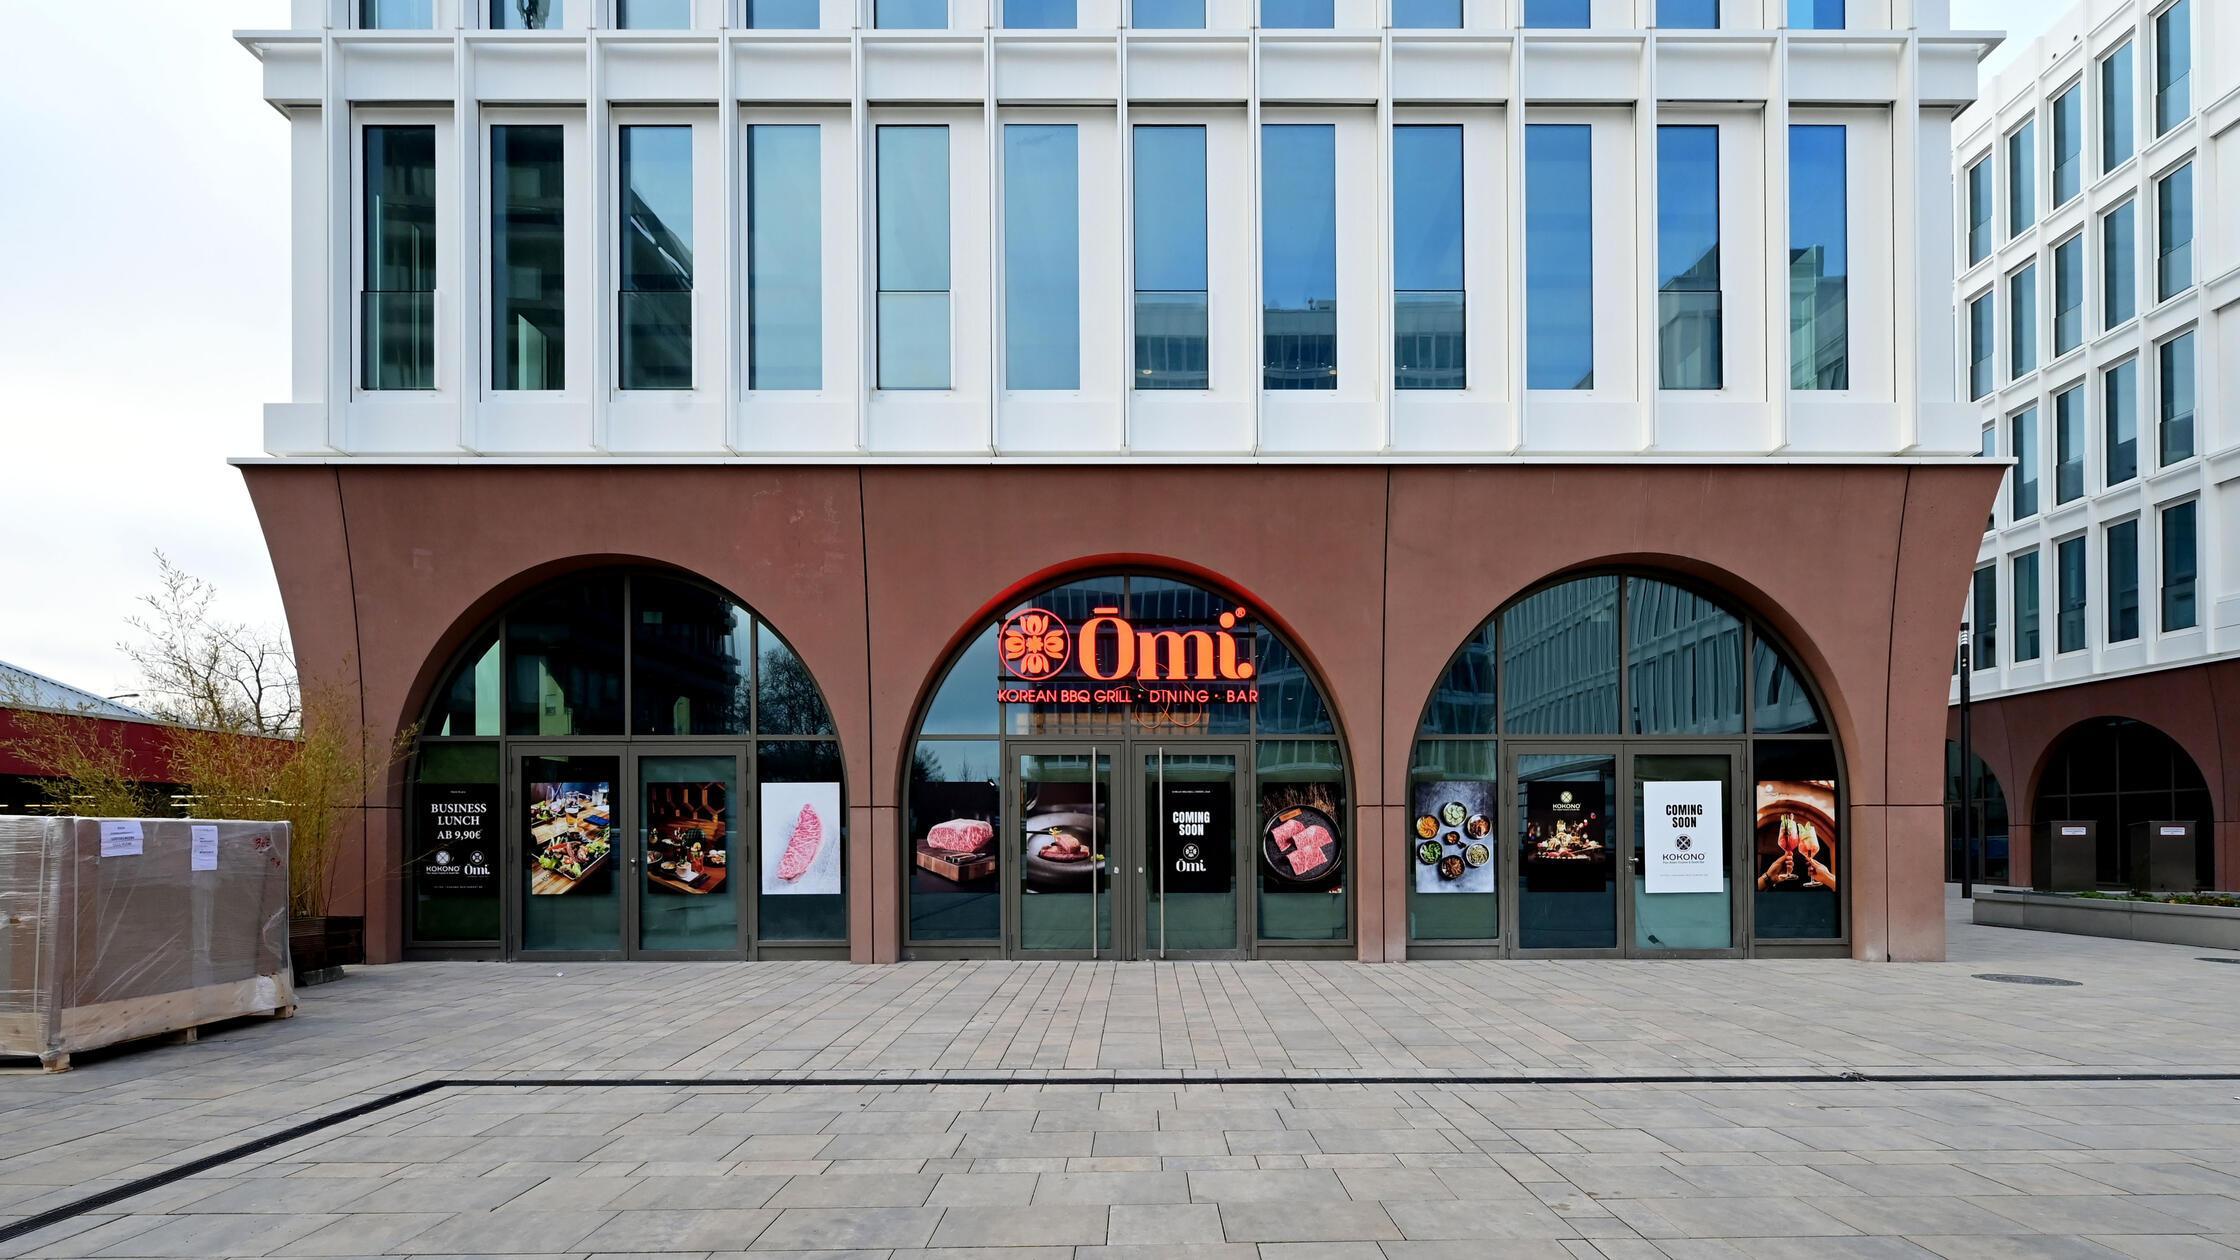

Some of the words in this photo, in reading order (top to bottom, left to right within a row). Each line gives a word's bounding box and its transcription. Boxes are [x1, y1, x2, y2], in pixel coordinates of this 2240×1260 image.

[998, 689, 1057, 703] KOREAN
[1061, 689, 1090, 703] BBQ
[1094, 689, 1133, 703] GRILL
[1149, 689, 1209, 703] DINING
[1226, 689, 1258, 703] BAR
[431, 803, 487, 813] BUSINESS
[1665, 804, 1703, 816] COMING
[438, 815, 480, 825] LUNCH
[1172, 811, 1211, 823] COMING
[1672, 816, 1697, 828] SOON
[437, 830, 452, 840] AB
[454, 830, 482, 841] 9,90€
[1178, 824, 1204, 836] SOON
[1662, 853, 1705, 861] KOKONO
